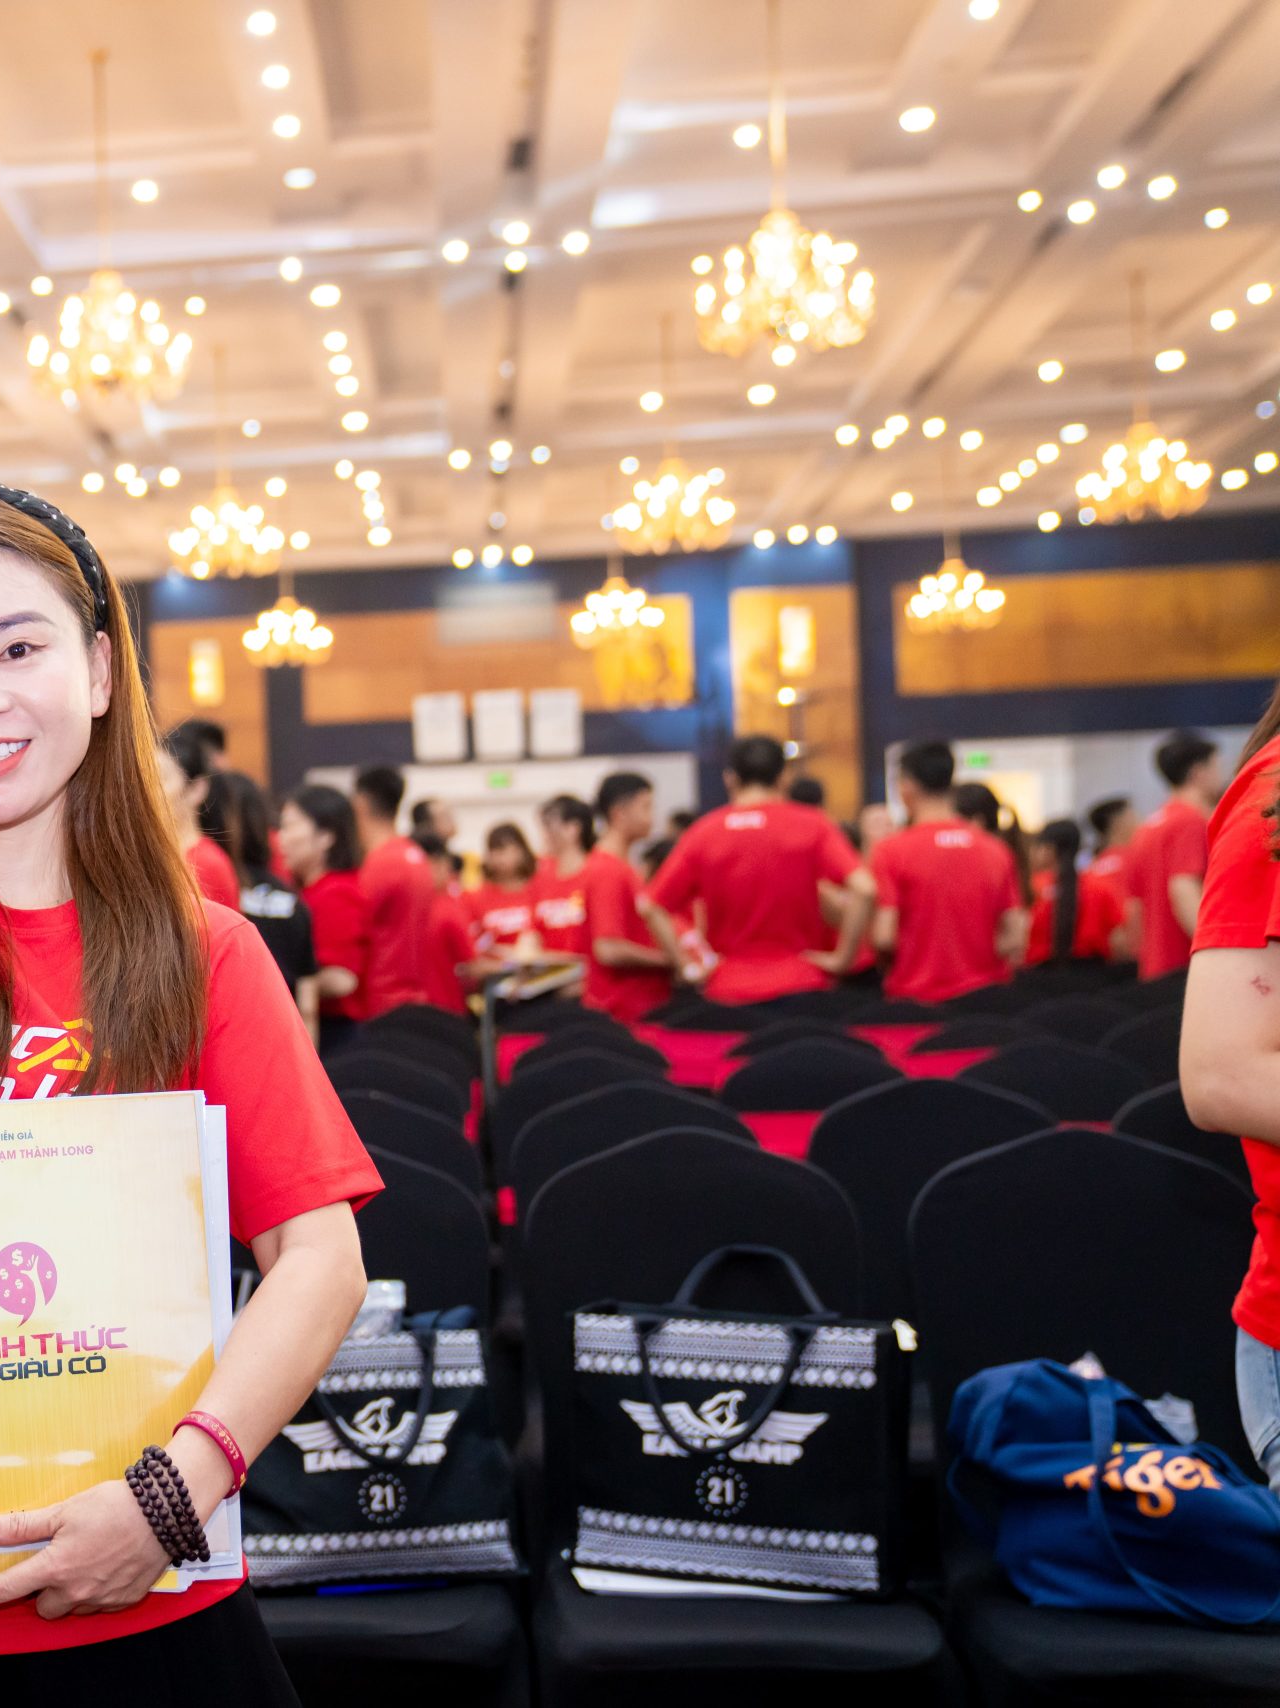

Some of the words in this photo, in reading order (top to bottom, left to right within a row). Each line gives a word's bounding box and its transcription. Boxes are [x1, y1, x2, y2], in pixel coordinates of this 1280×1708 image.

[19, 1146, 59, 1159] THÀNH
[62, 1145, 94, 1156] LONG
[30, 1325, 129, 1354] THỨC
[68, 1352, 107, 1375] CÓ
[369, 1484, 396, 1512] 21
[707, 1476, 735, 1505] 21
